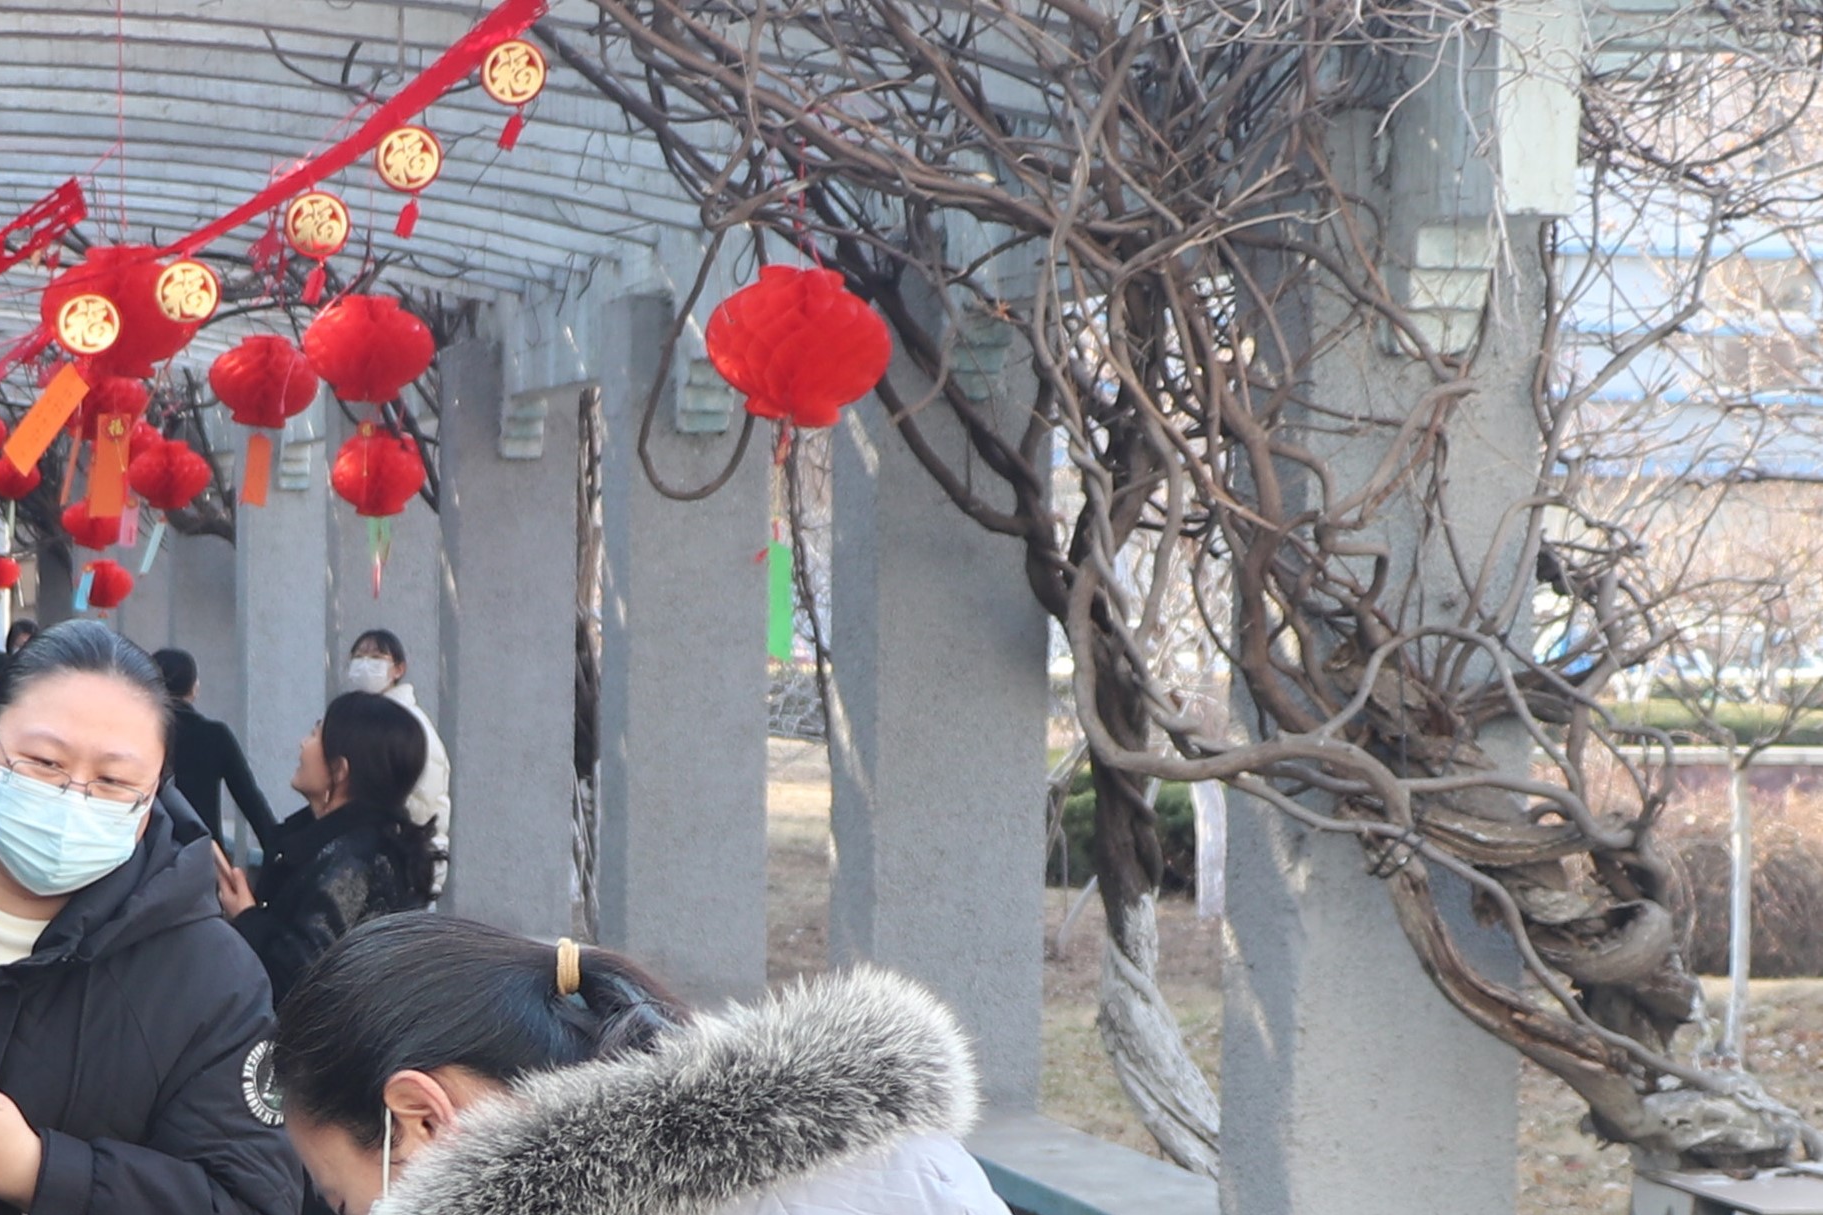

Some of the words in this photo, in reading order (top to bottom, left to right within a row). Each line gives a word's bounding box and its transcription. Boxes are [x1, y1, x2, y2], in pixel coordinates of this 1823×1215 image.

[486, 44, 542, 98] 福
[380, 131, 437, 185] 福
[289, 196, 344, 249] 福
[159, 265, 214, 319] 福
[60, 296, 117, 350] 福
